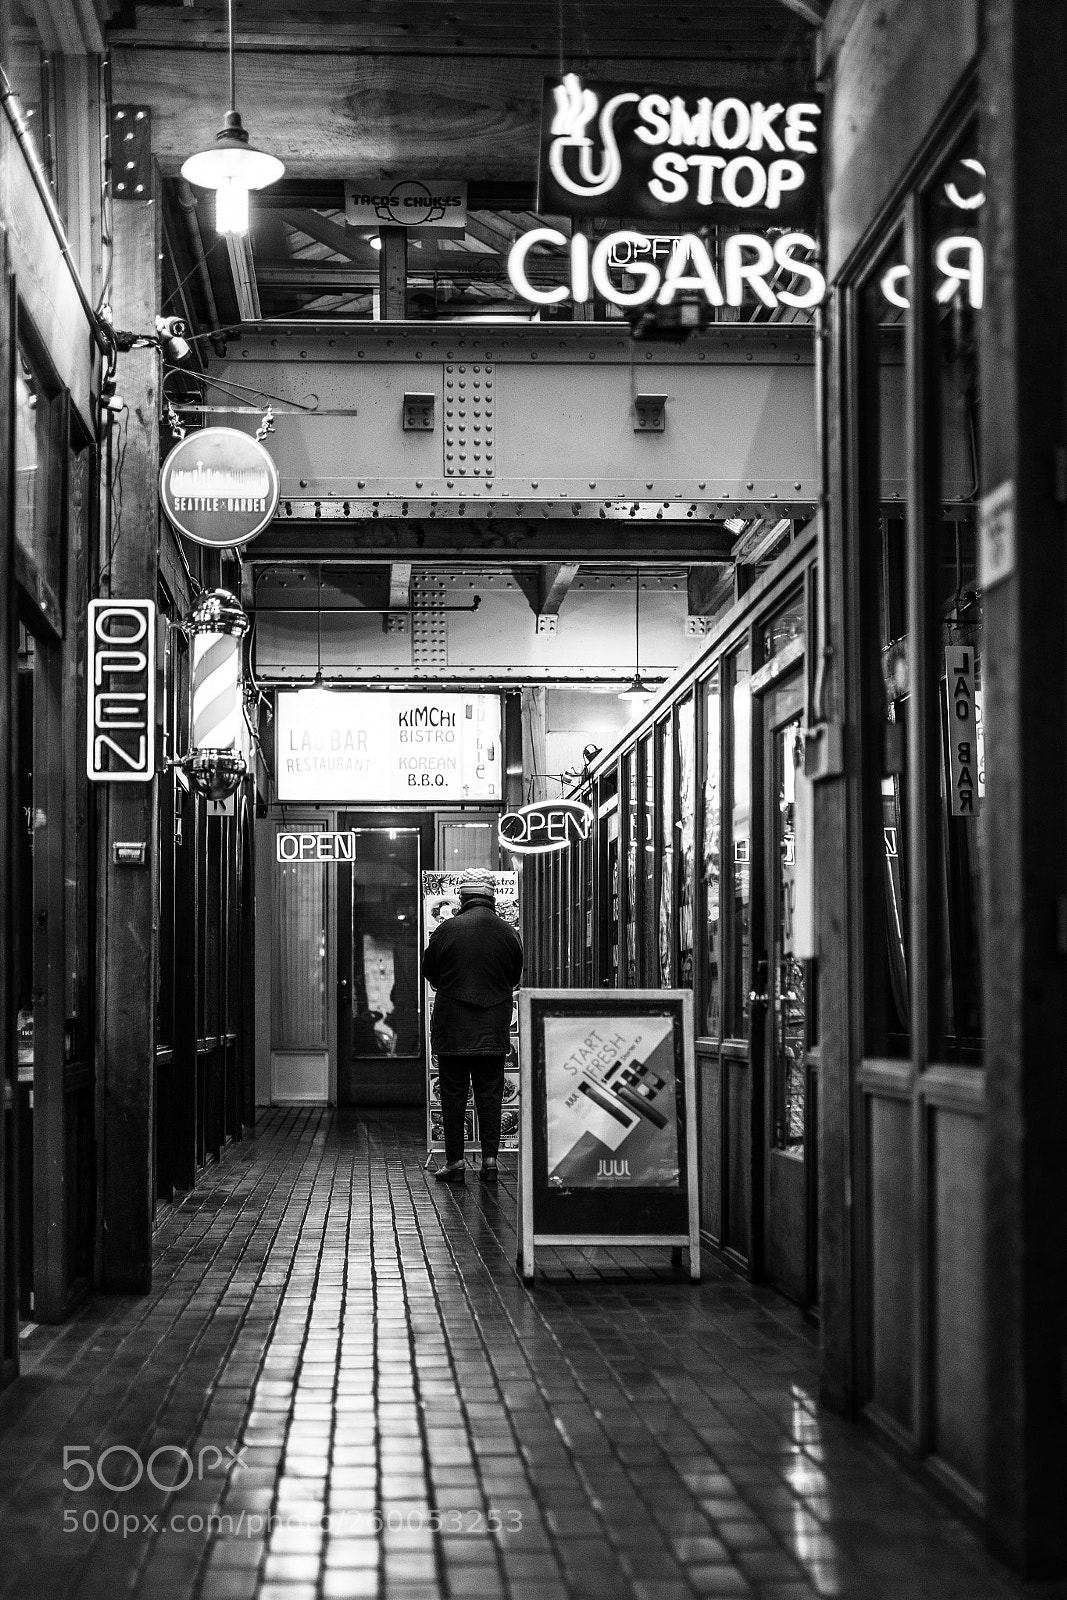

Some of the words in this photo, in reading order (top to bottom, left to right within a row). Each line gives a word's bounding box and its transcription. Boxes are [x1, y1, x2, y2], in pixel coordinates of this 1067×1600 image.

[633, 93, 822, 155] SMOKE
[647, 152, 806, 210] STOP
[352, 194, 399, 206] TACOS
[507, 228, 826, 308] CIGARS
[174, 497, 219, 512] SEATTLE
[227, 498, 266, 512] BARBER
[95, 608, 147, 771] OPEN
[398, 706, 456, 727] KIMCHI
[331, 729, 368, 751] BAR
[400, 730, 455, 742] BISTRO
[287, 757, 371, 773] RESTAURANT
[399, 756, 456, 769] KOREAN
[407, 773, 449, 786] B.B.Q.
[499, 811, 590, 841] OPEN
[280, 834, 352, 860] OPEN
[563, 1030, 603, 1076] START
[586, 1032, 627, 1078] FRESH
[597, 1159, 632, 1176] JUUL
